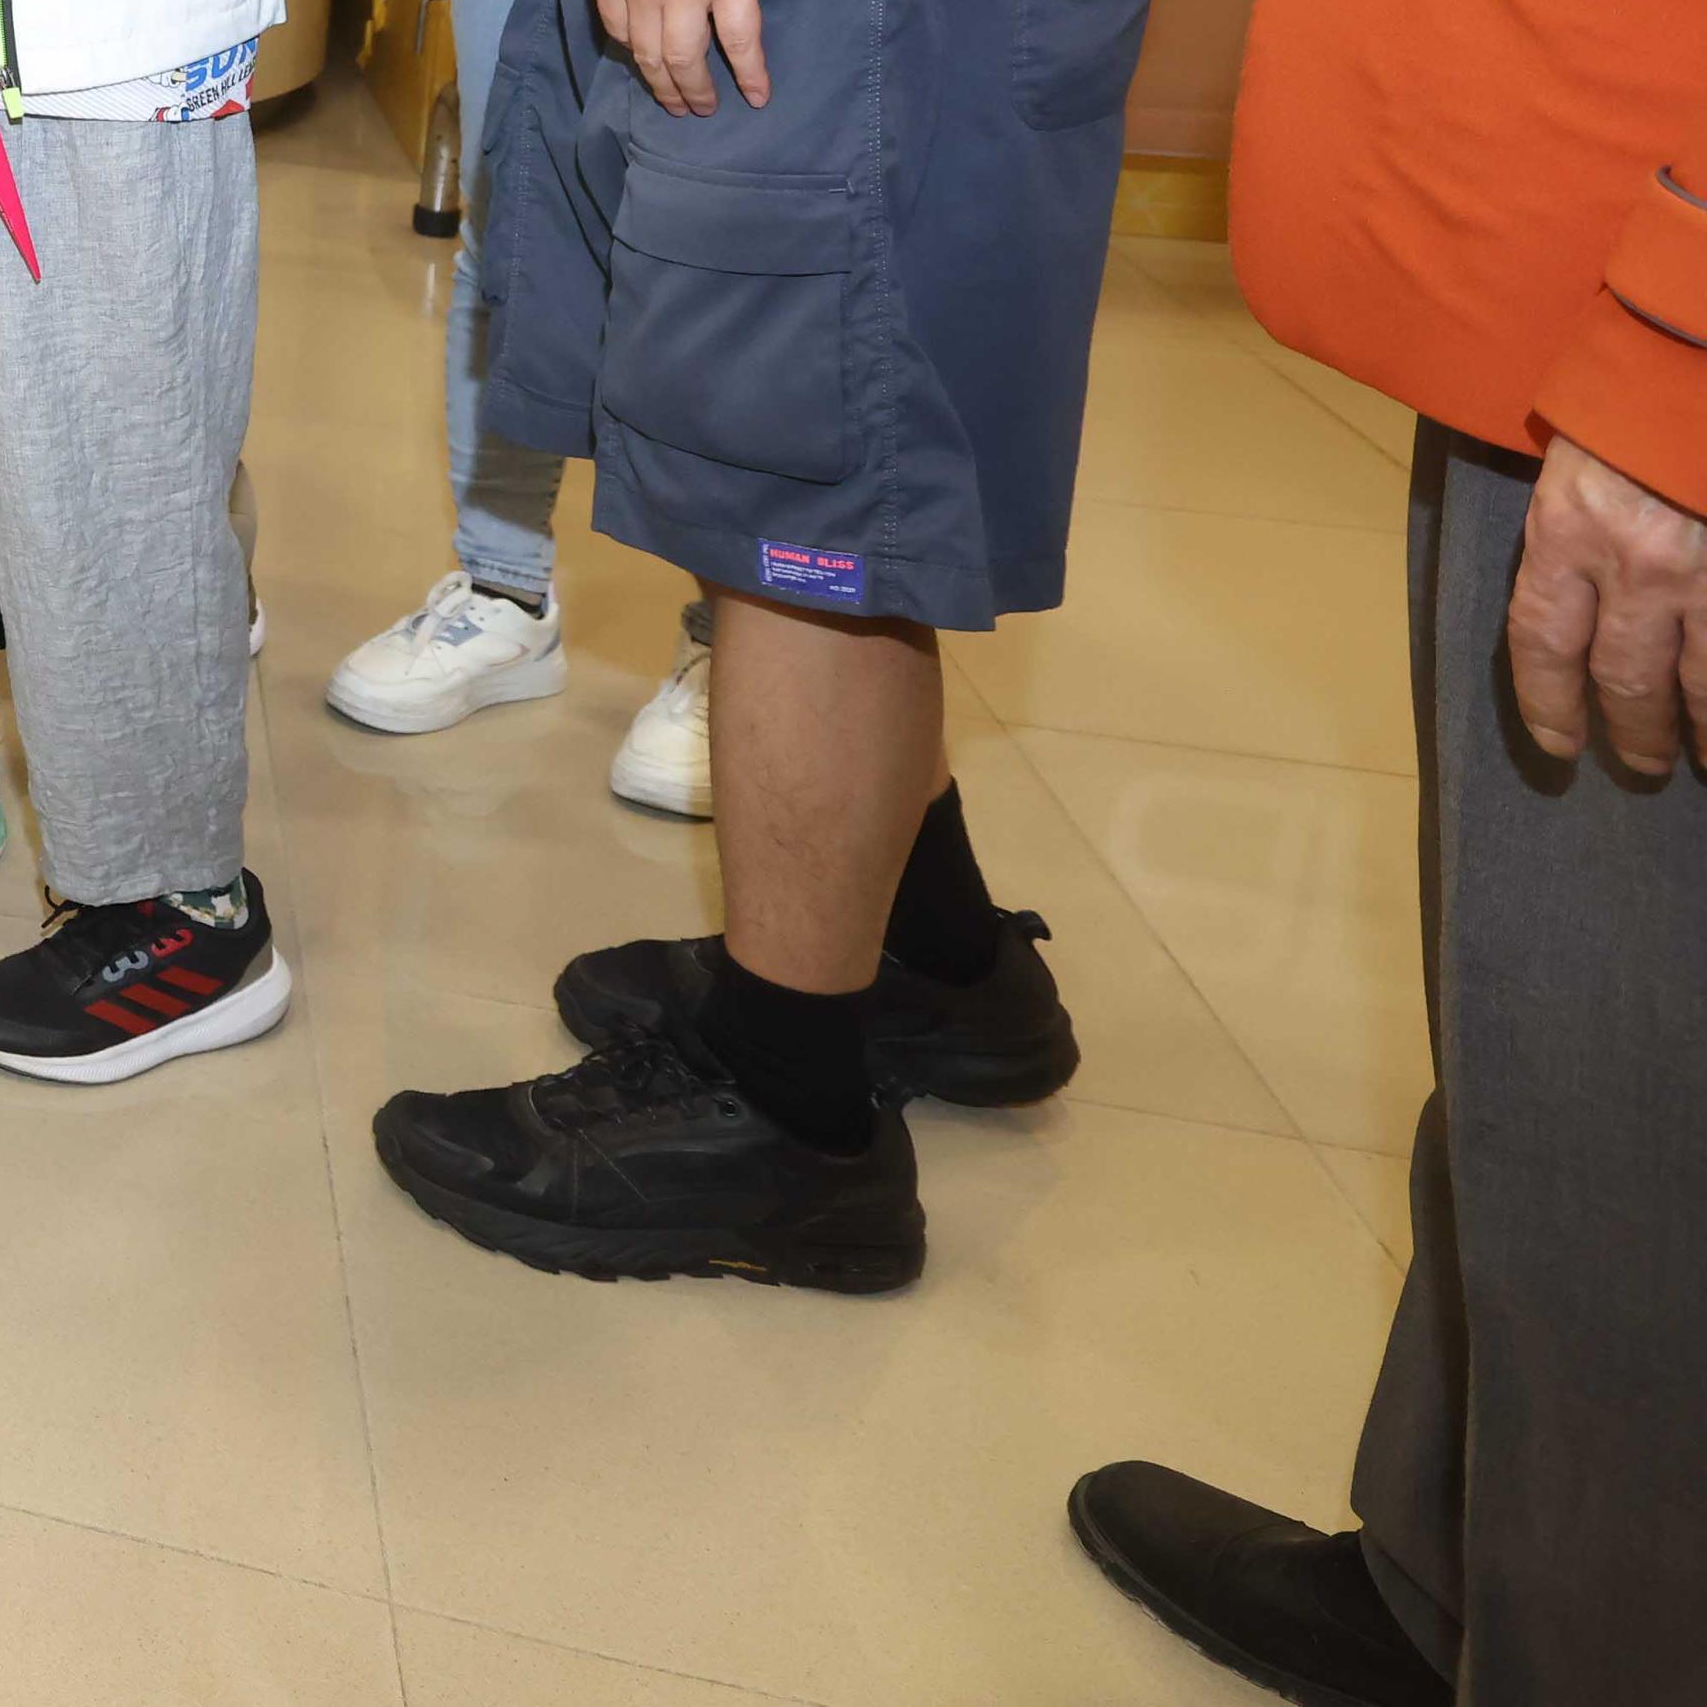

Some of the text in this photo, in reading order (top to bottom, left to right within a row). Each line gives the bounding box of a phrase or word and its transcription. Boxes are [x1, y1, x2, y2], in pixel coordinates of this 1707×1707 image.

[187, 84, 219, 112] GREEN
[769, 548, 811, 565] HUMAN
[817, 556, 855, 571] BLISS
